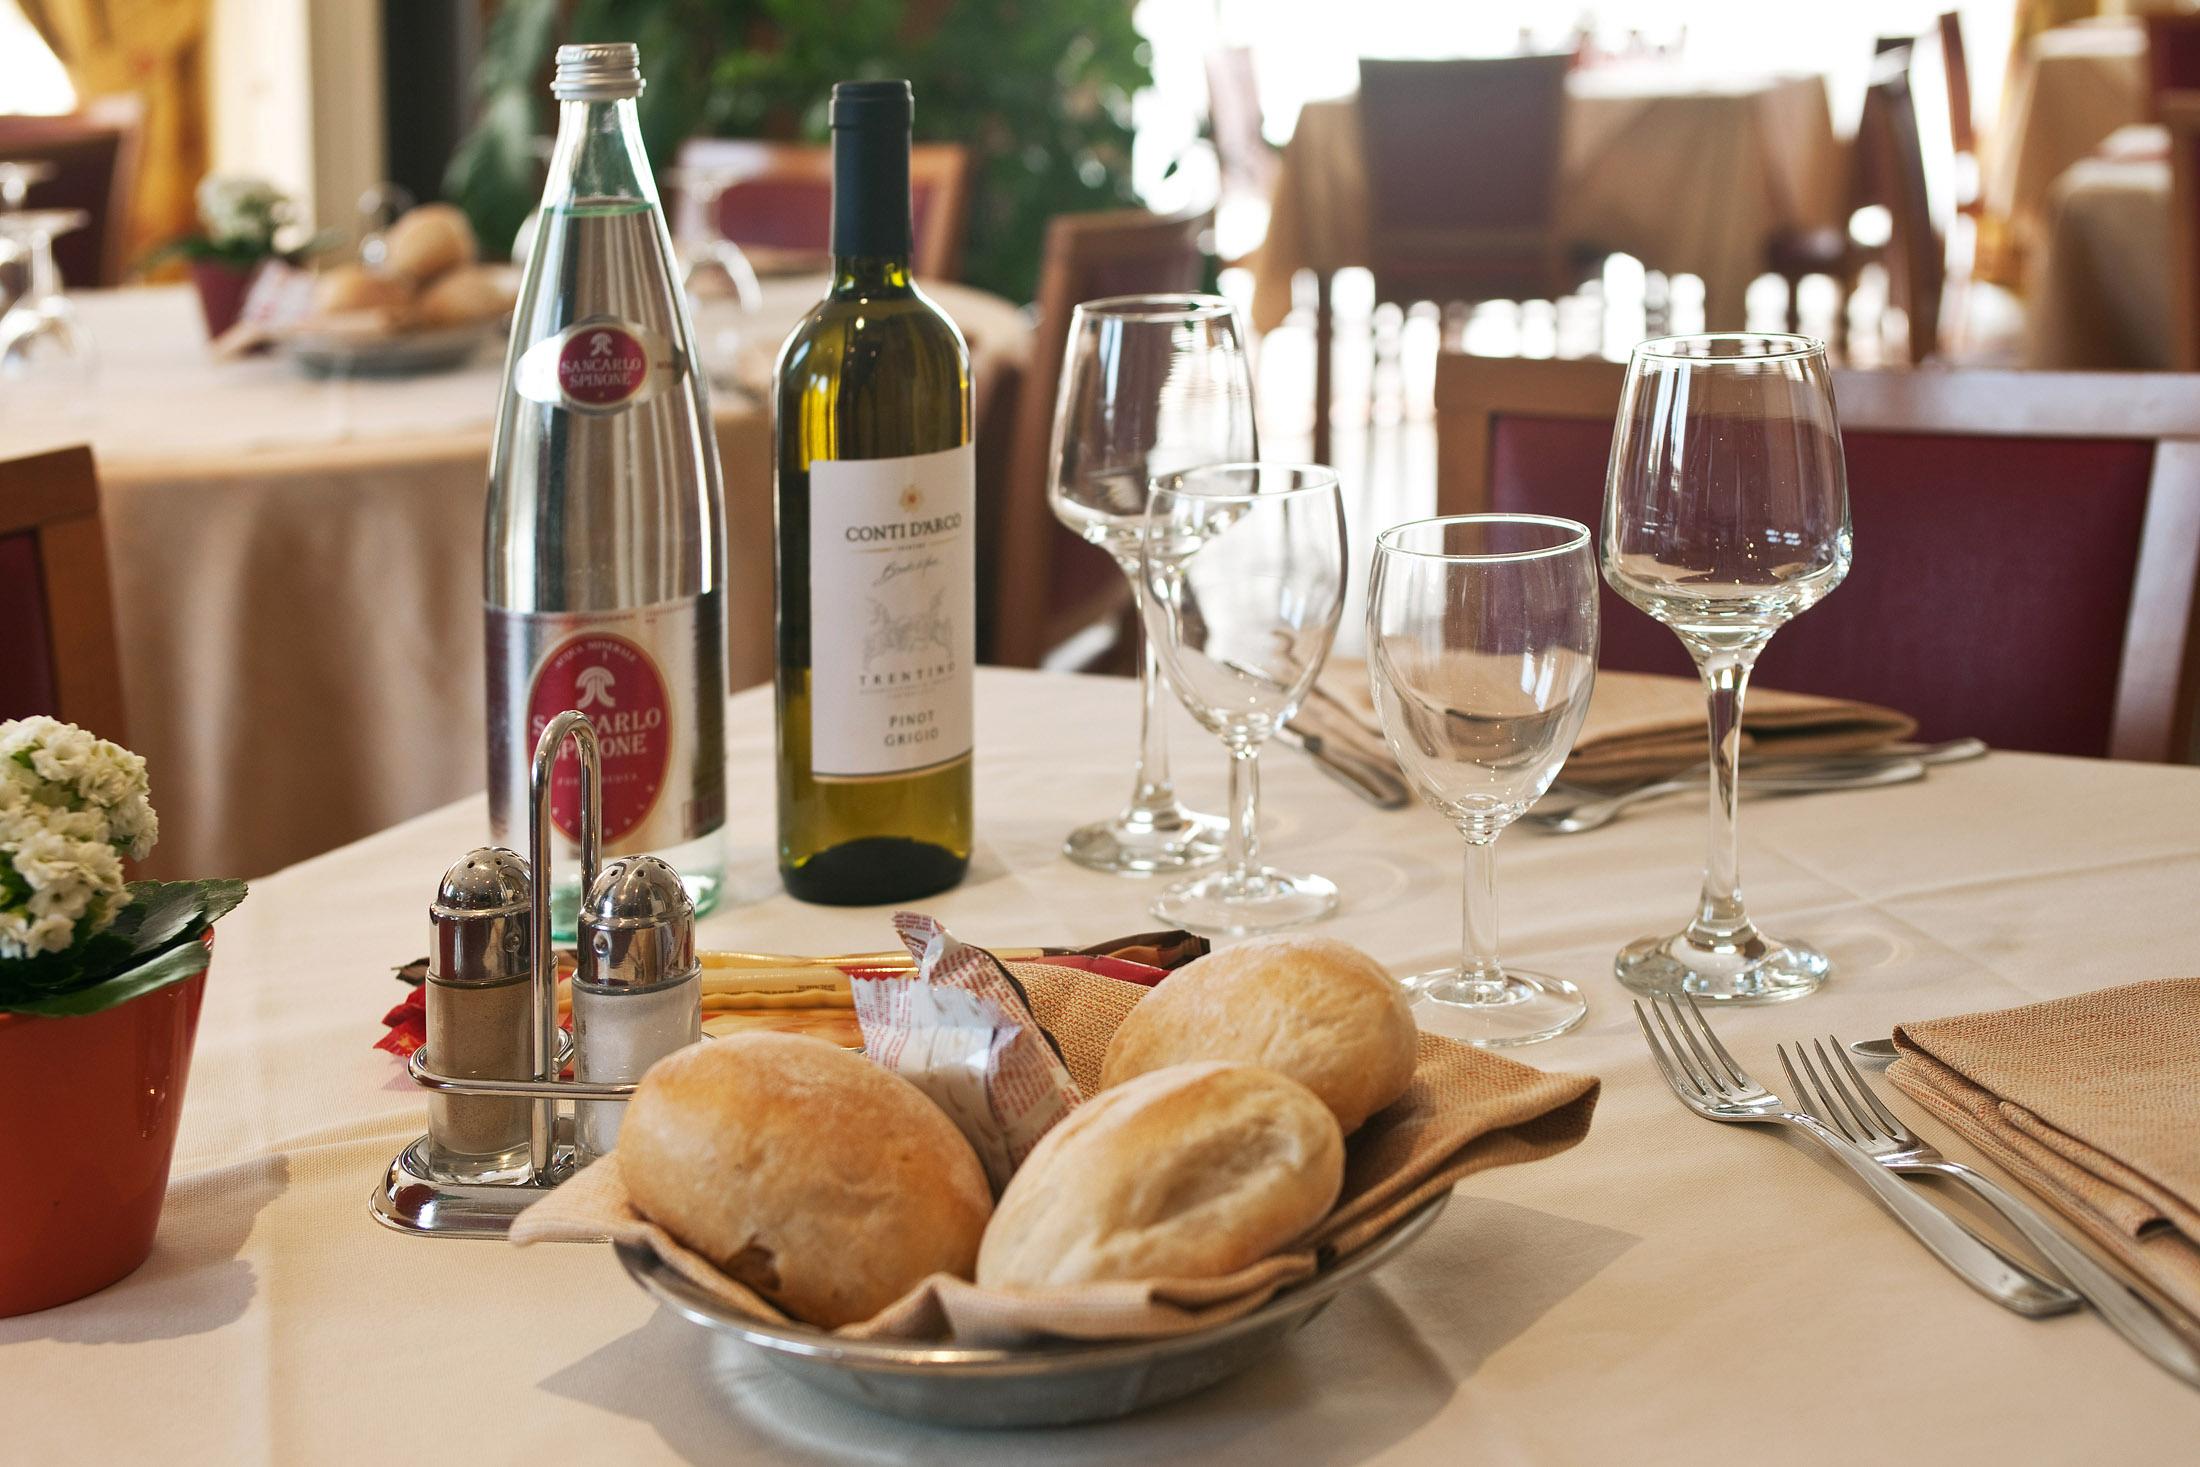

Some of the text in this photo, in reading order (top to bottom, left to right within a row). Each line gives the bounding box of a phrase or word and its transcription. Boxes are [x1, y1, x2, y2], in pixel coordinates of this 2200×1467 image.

[846, 512, 962, 542] CONTI D'ARCO
[859, 661, 956, 686] TRENTINO
[889, 709, 935, 728] PINOT
[884, 727, 939, 746] GRIGIO
